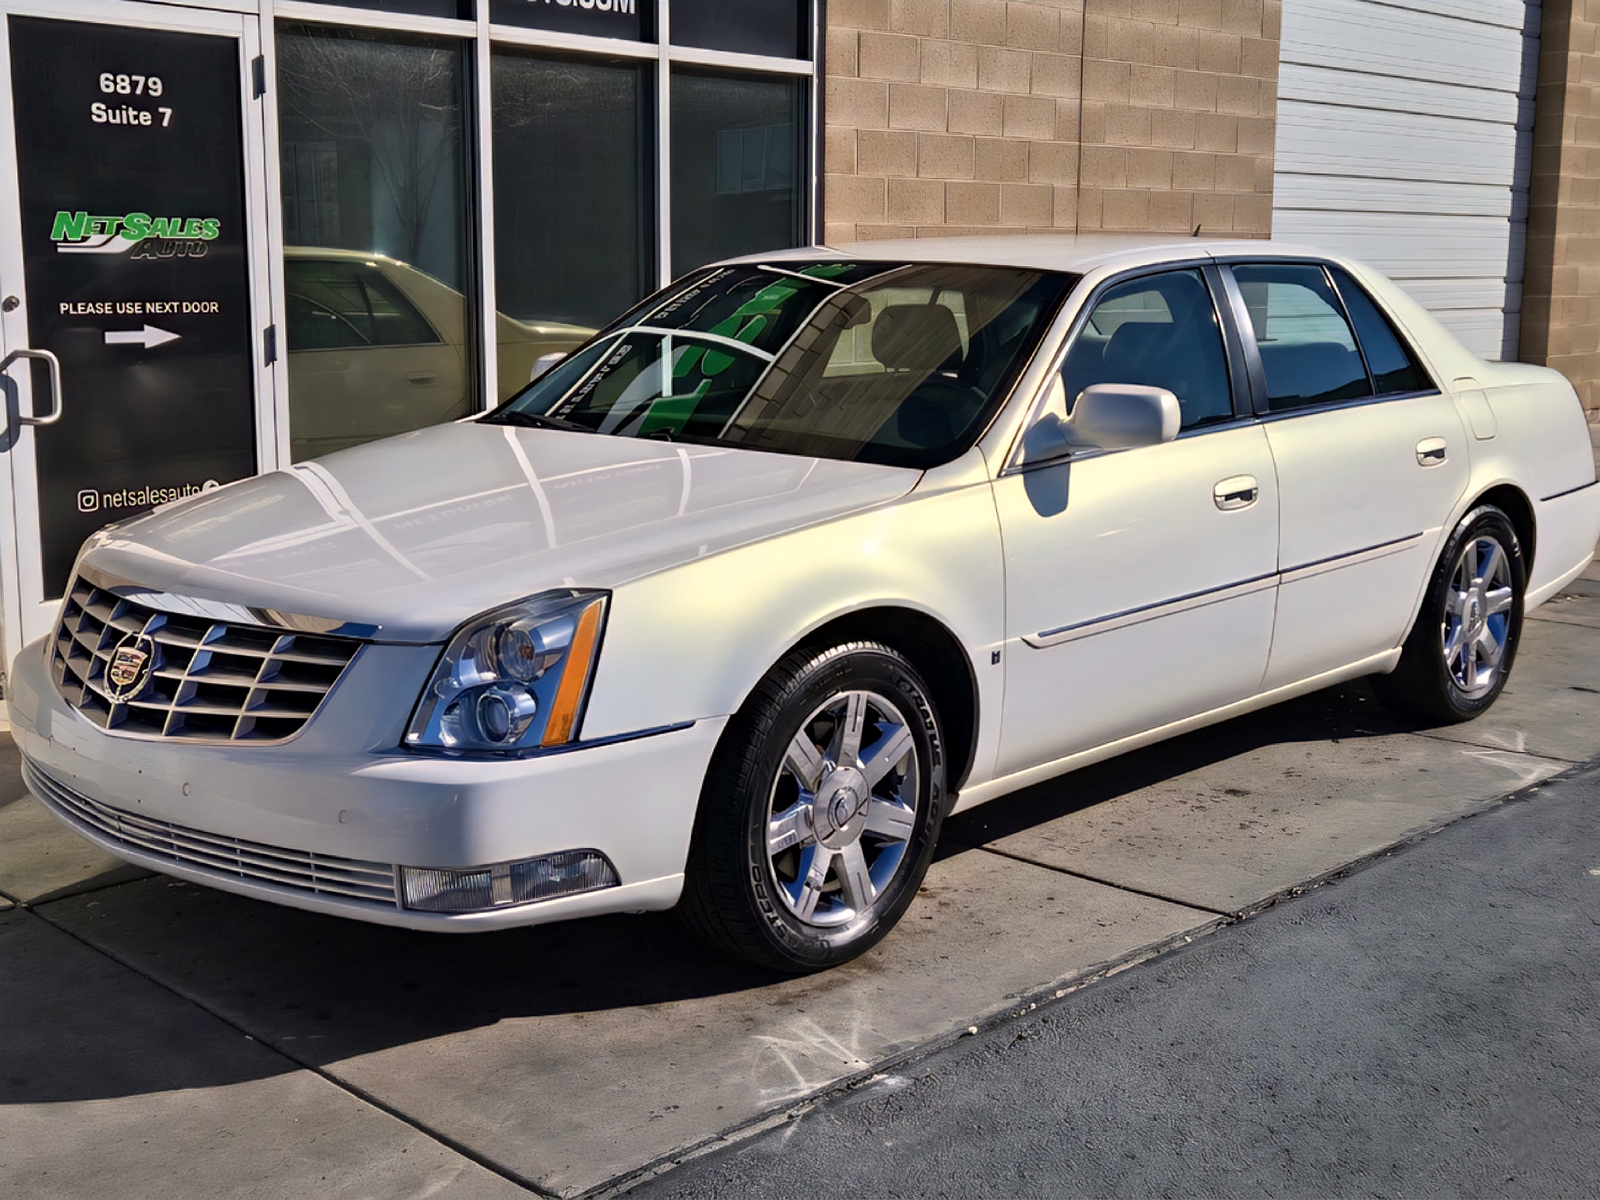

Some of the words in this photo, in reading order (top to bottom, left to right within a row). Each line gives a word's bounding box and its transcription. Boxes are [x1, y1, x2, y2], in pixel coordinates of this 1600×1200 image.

[99, 72, 163, 97] 6879
[91, 102, 152, 126] Suite
[158, 106, 173, 127] 7
[130, 241, 209, 260] AUTO
[59, 302, 113, 315] PLEASE
[116, 302, 143, 314] USE
[146, 302, 180, 314] NEXT
[182, 301, 219, 314] DOOR
[103, 483, 201, 509] netsalesauto
